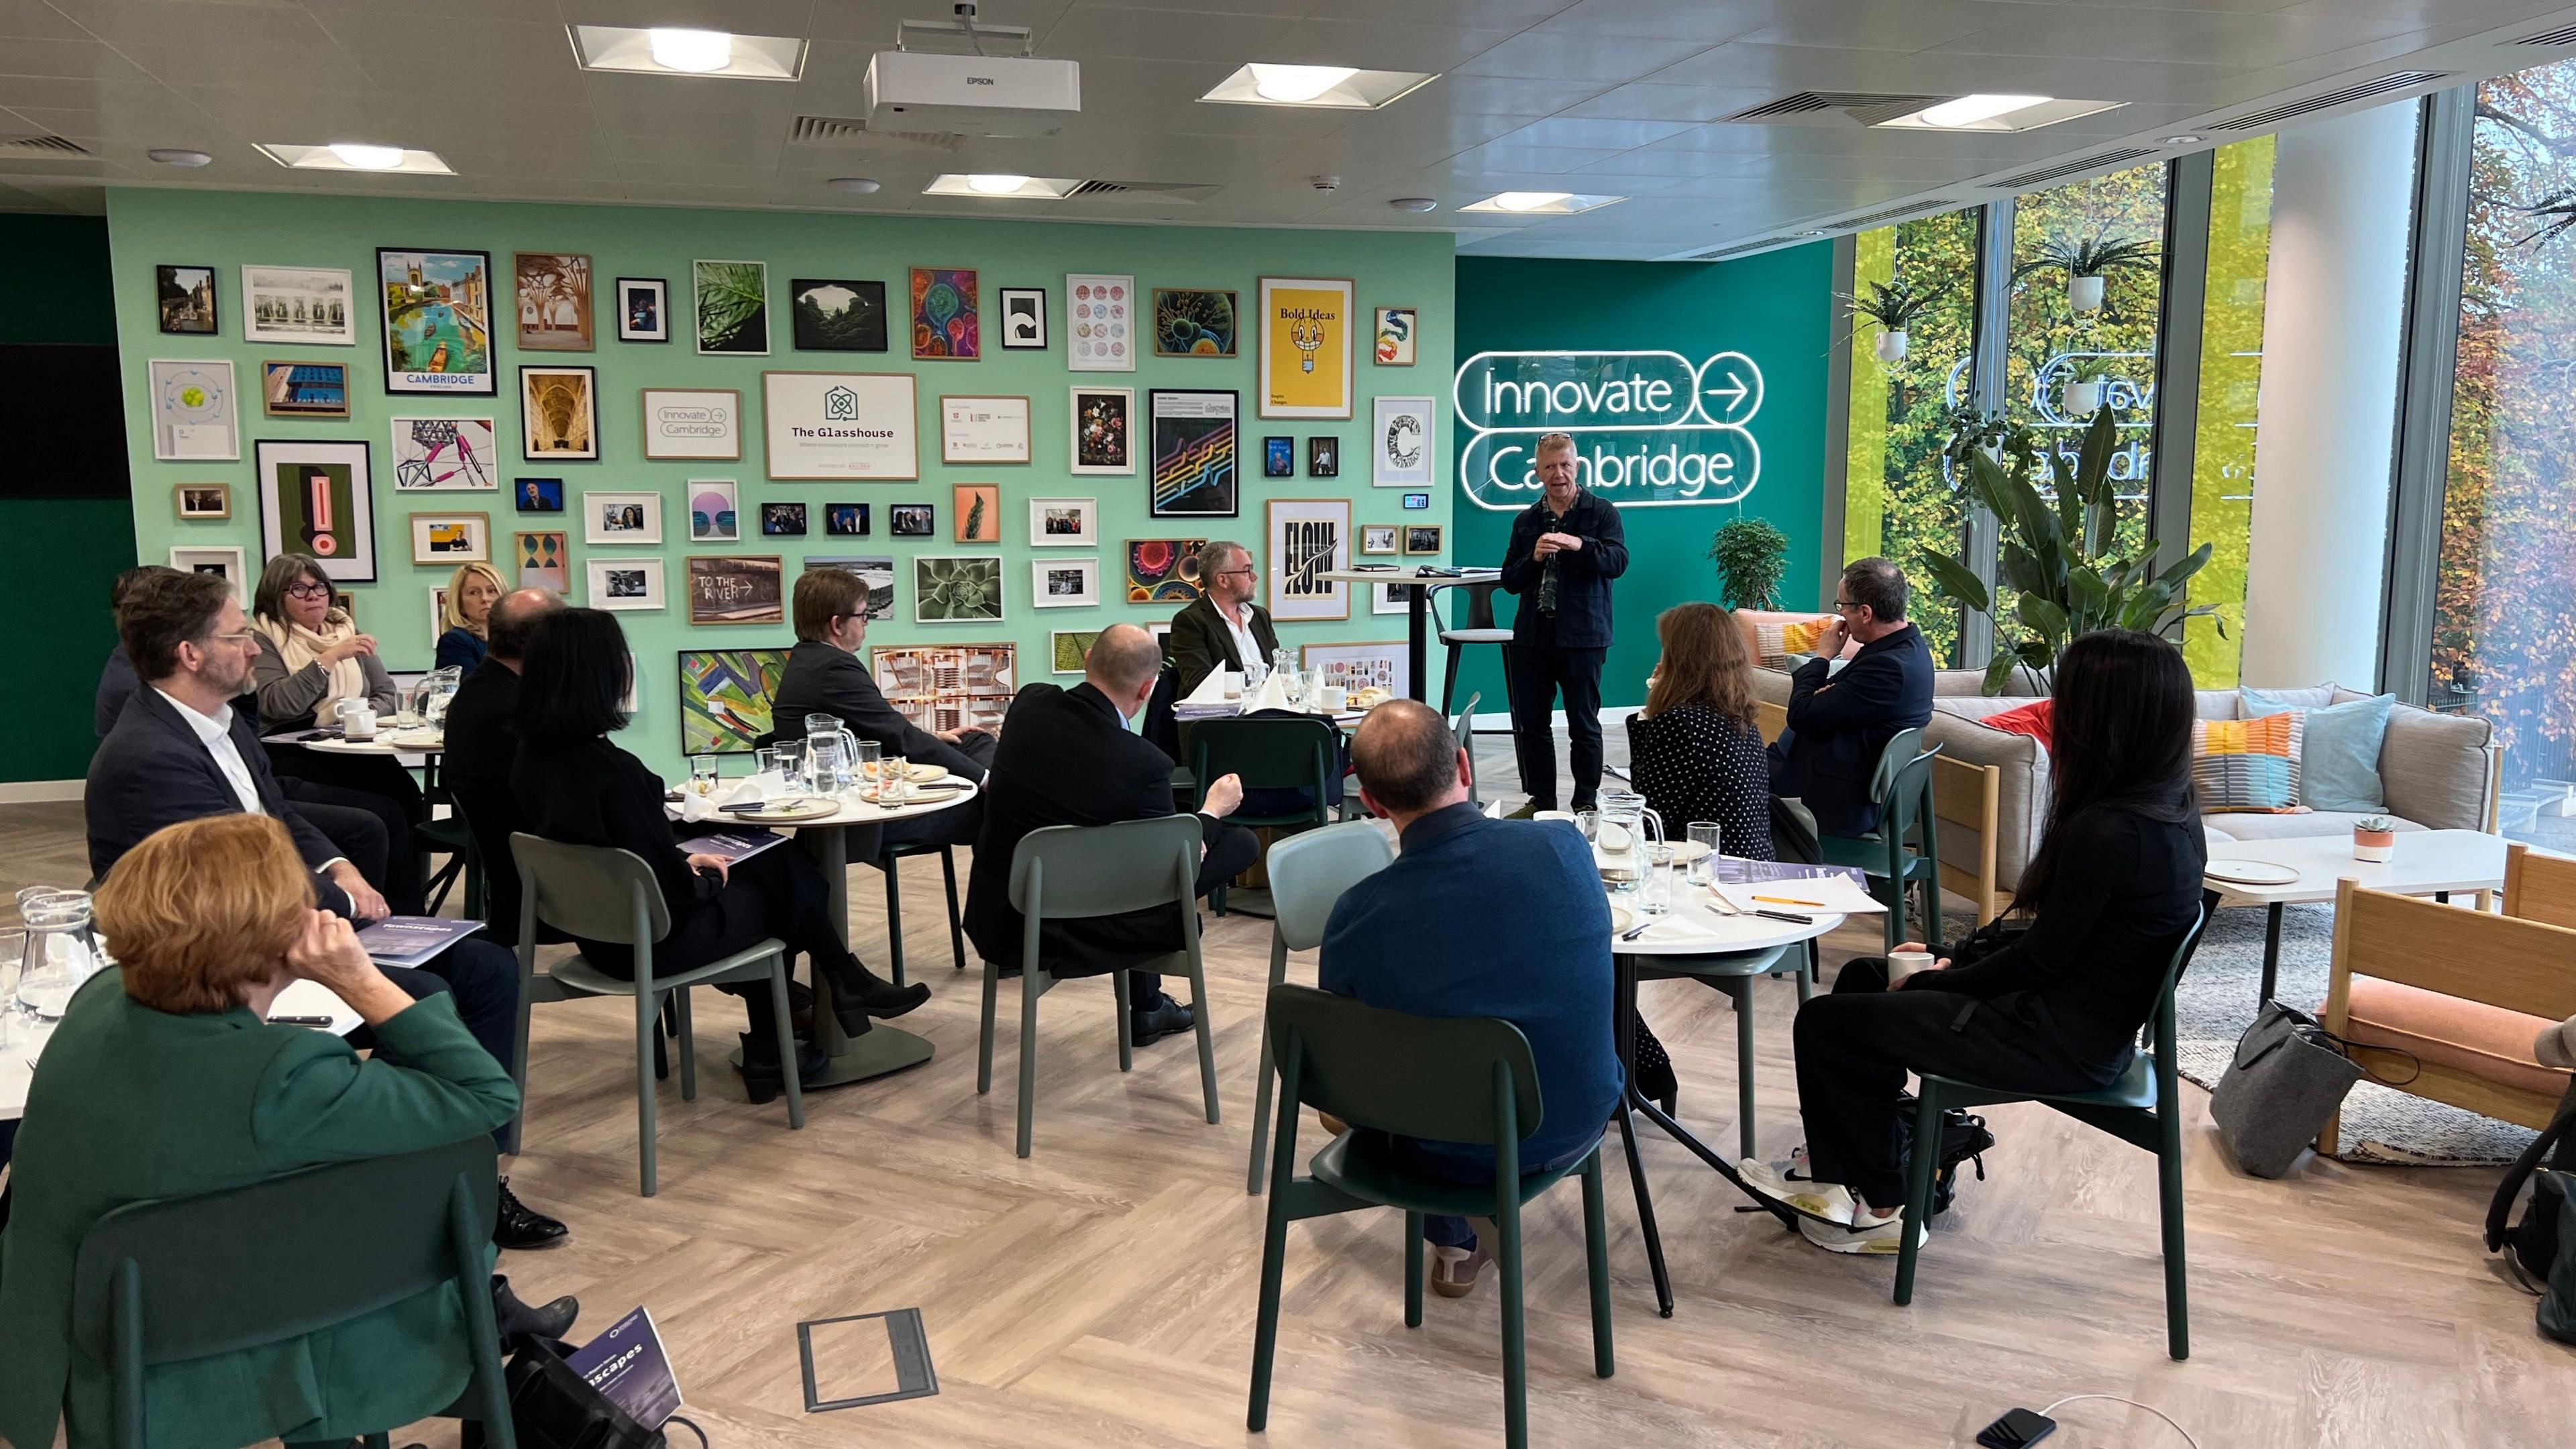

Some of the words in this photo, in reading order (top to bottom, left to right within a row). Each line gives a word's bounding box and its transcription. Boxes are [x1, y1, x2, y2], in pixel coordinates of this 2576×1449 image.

[967, 76, 994, 85] EPSON
[1280, 308, 1305, 319] Bold
[1309, 309, 1336, 319] Ideas
[407, 374, 475, 384] CAMBRIDGE
[1485, 370, 1673, 414] Innovate
[663, 409, 706, 419] Innovate
[666, 423, 721, 437] Cambridge
[792, 427, 814, 437] The
[818, 427, 894, 437] Glasshouse
[1285, 521, 1338, 594] FLOW
[698, 576, 712, 588] TO
[716, 576, 736, 587] THE
[704, 586, 739, 600] RIVER
